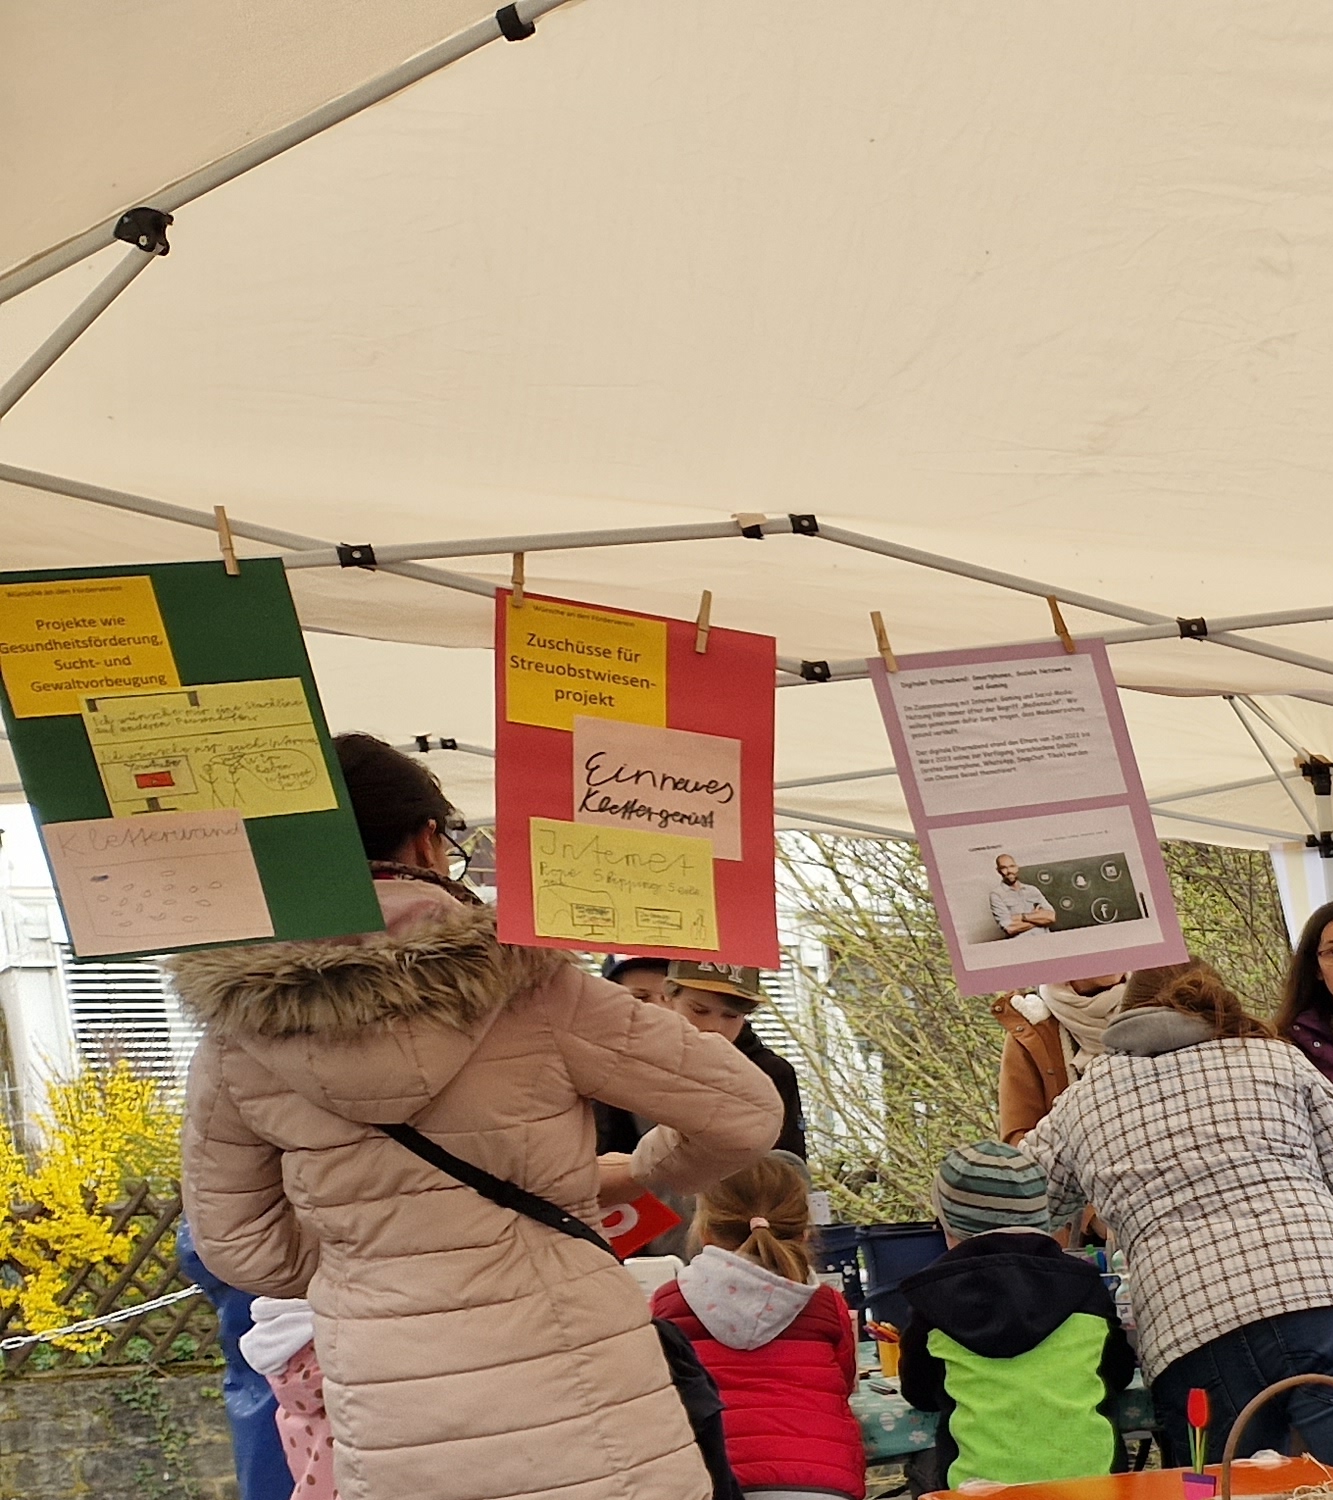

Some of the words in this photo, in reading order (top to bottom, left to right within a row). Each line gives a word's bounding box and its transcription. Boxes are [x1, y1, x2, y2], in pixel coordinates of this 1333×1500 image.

[35, 617, 97, 632] Projekte
[100, 616, 126, 626] wie
[0, 634, 163, 654] Gesundheitsförderung,
[526, 632, 613, 660] Zuschüsse
[617, 647, 642, 664] für
[54, 658, 100, 670] Sucht-
[104, 655, 132, 667] und
[509, 655, 657, 689] Streuobstwiesen-
[30, 673, 167, 692] Gewaltvorbeugung
[554, 688, 616, 708] projekt
